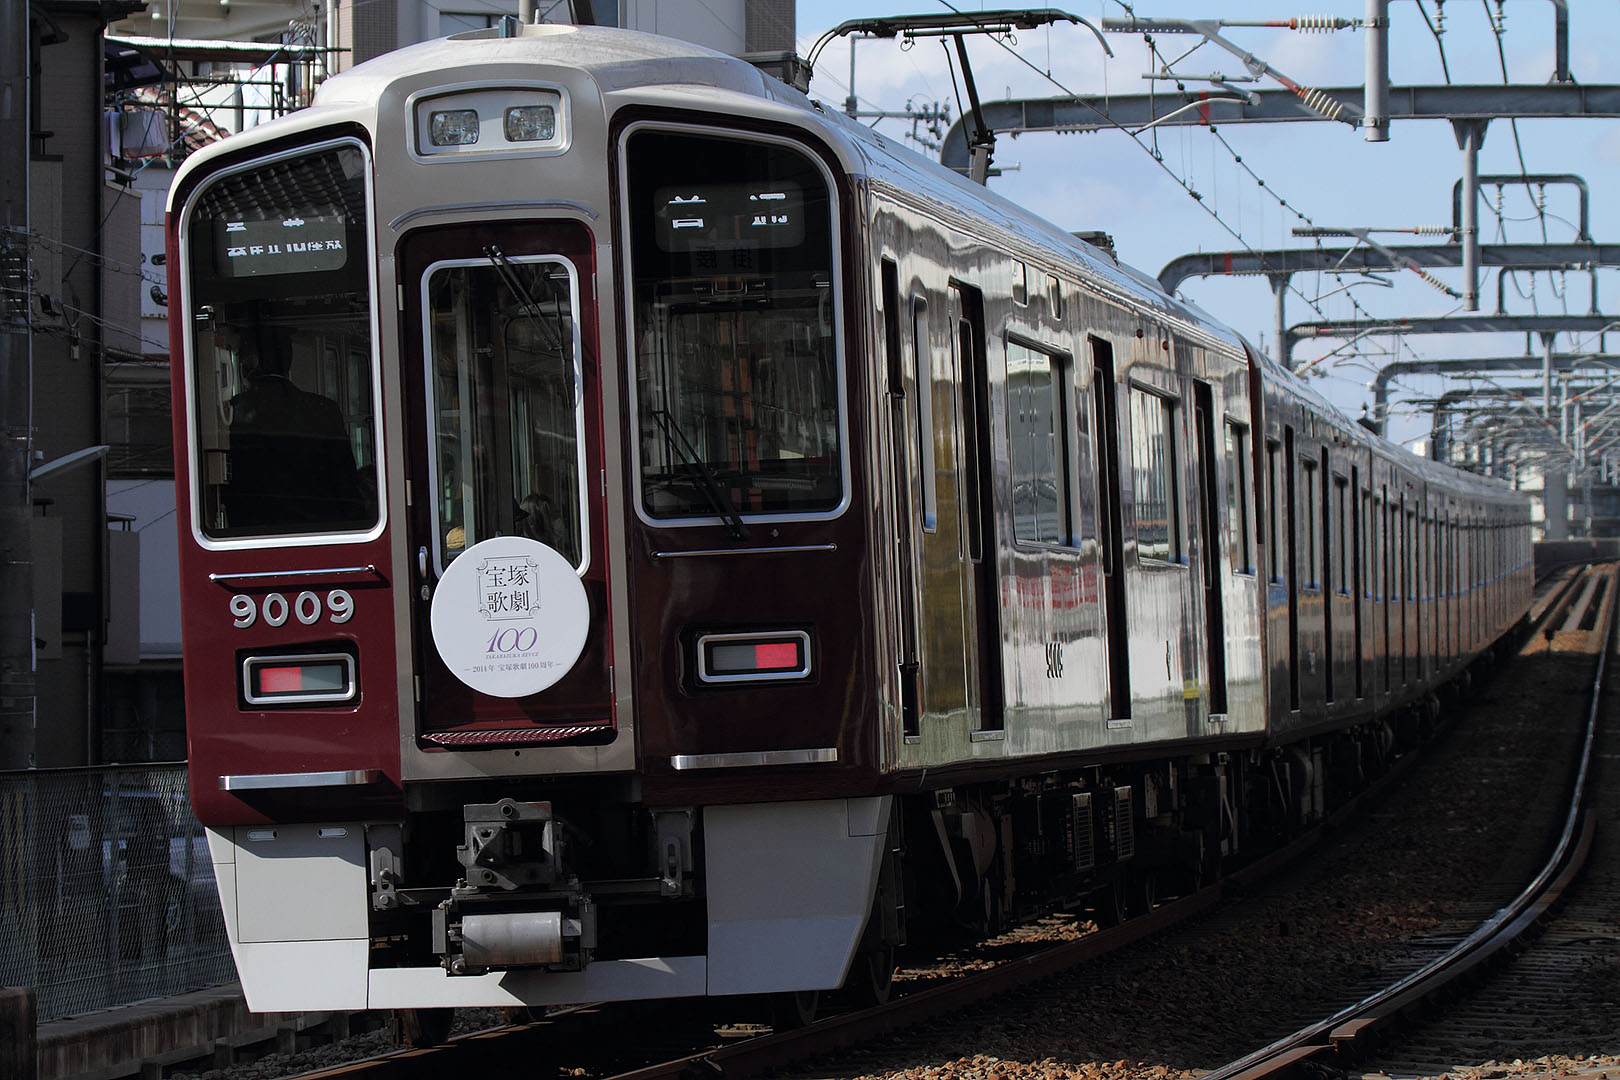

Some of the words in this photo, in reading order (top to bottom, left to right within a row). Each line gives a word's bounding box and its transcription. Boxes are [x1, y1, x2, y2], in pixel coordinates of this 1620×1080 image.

[485, 564, 530, 588] 宝塚
[229, 589, 355, 629] 9009
[487, 590, 530, 613] 歌劇
[486, 626, 538, 653] 100
